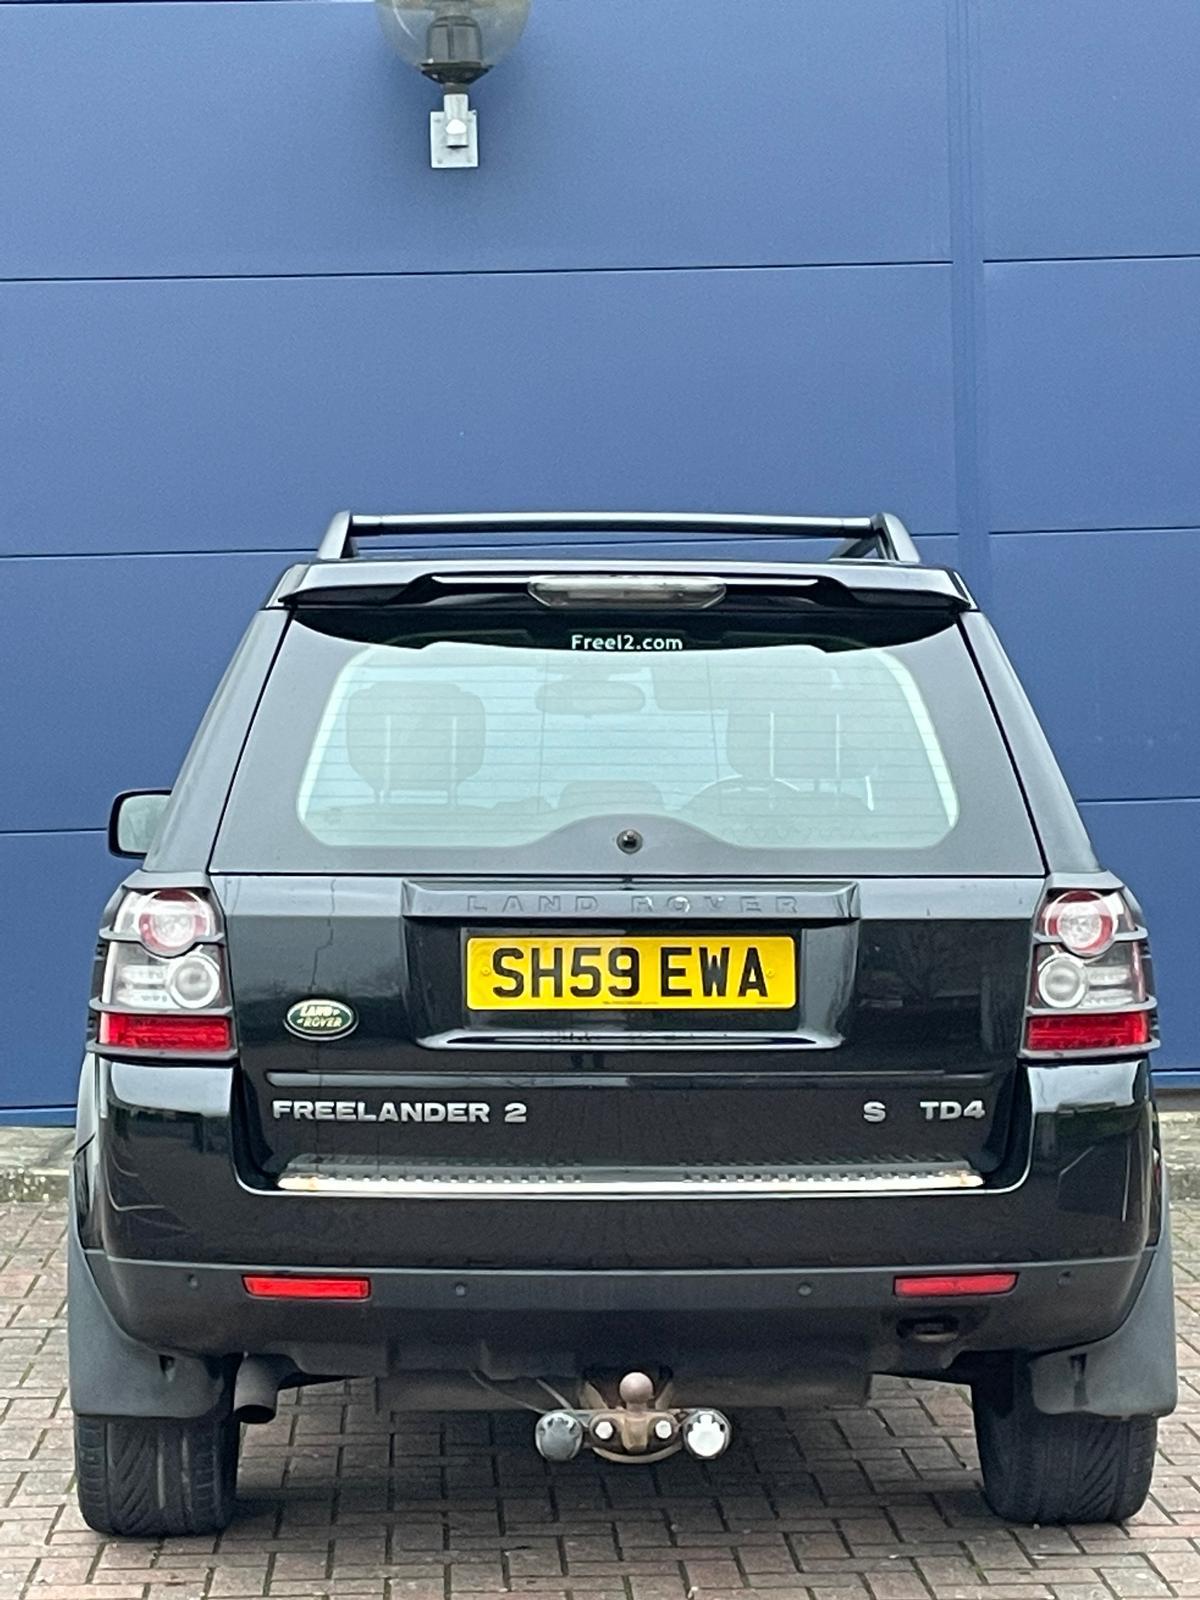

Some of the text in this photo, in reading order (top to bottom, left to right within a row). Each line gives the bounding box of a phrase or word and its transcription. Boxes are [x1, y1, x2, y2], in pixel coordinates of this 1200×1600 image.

[467, 895, 799, 913] LAND ROVER
[492, 947, 768, 998] SH59 EWA
[272, 1100, 527, 1123] FREELANDER 2
[863, 1100, 985, 1122] S TD4
